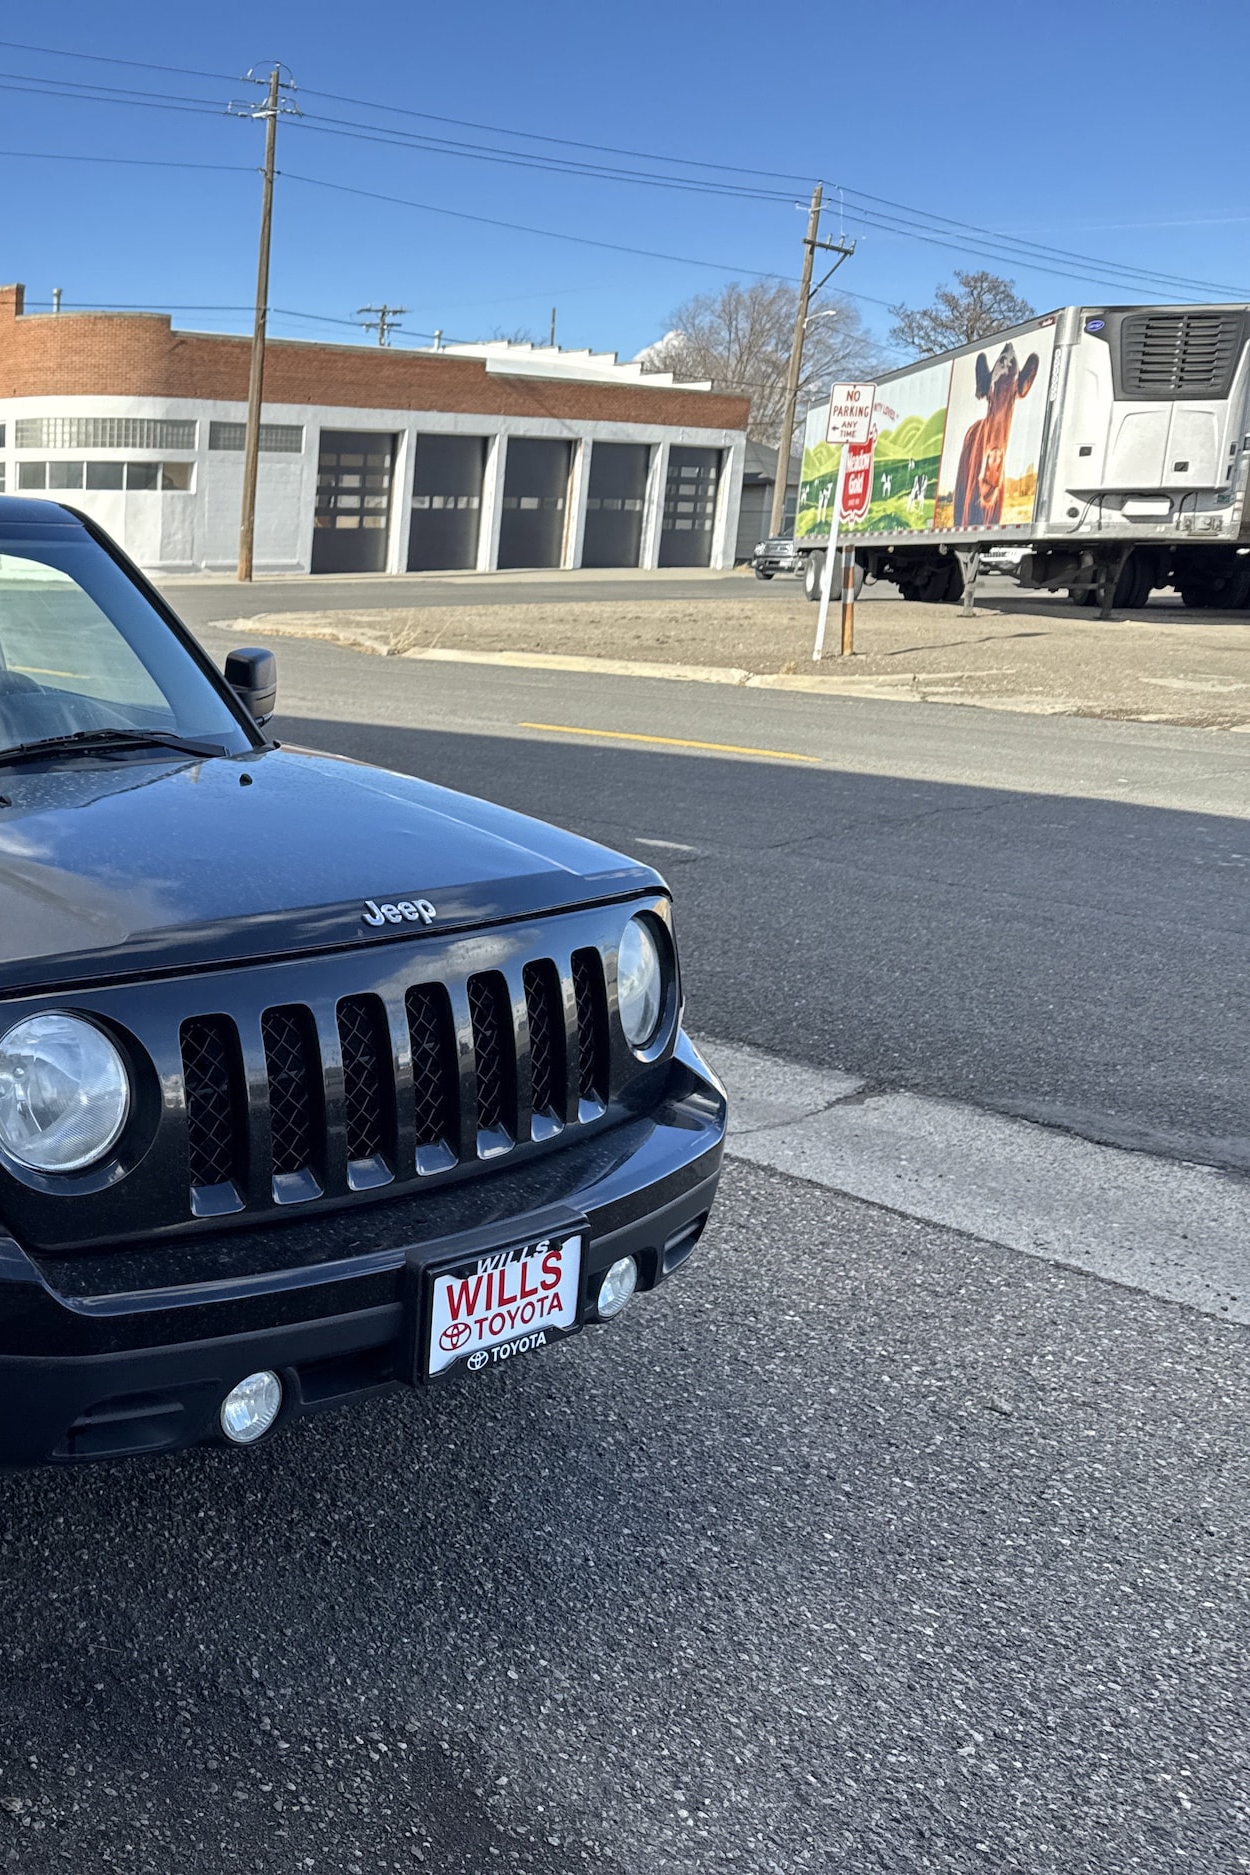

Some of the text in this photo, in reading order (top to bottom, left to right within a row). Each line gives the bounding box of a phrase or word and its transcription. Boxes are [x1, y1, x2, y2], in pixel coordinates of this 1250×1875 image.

[846, 390, 861, 402] NO
[833, 405, 869, 418] PARKING
[840, 430, 856, 438] TIME
[362, 899, 436, 926] Jeep
[477, 1240, 551, 1274] WILLS
[446, 1250, 562, 1321] WILLS
[474, 1292, 563, 1340] TOYOTA
[491, 1331, 547, 1362] TOYOTA
